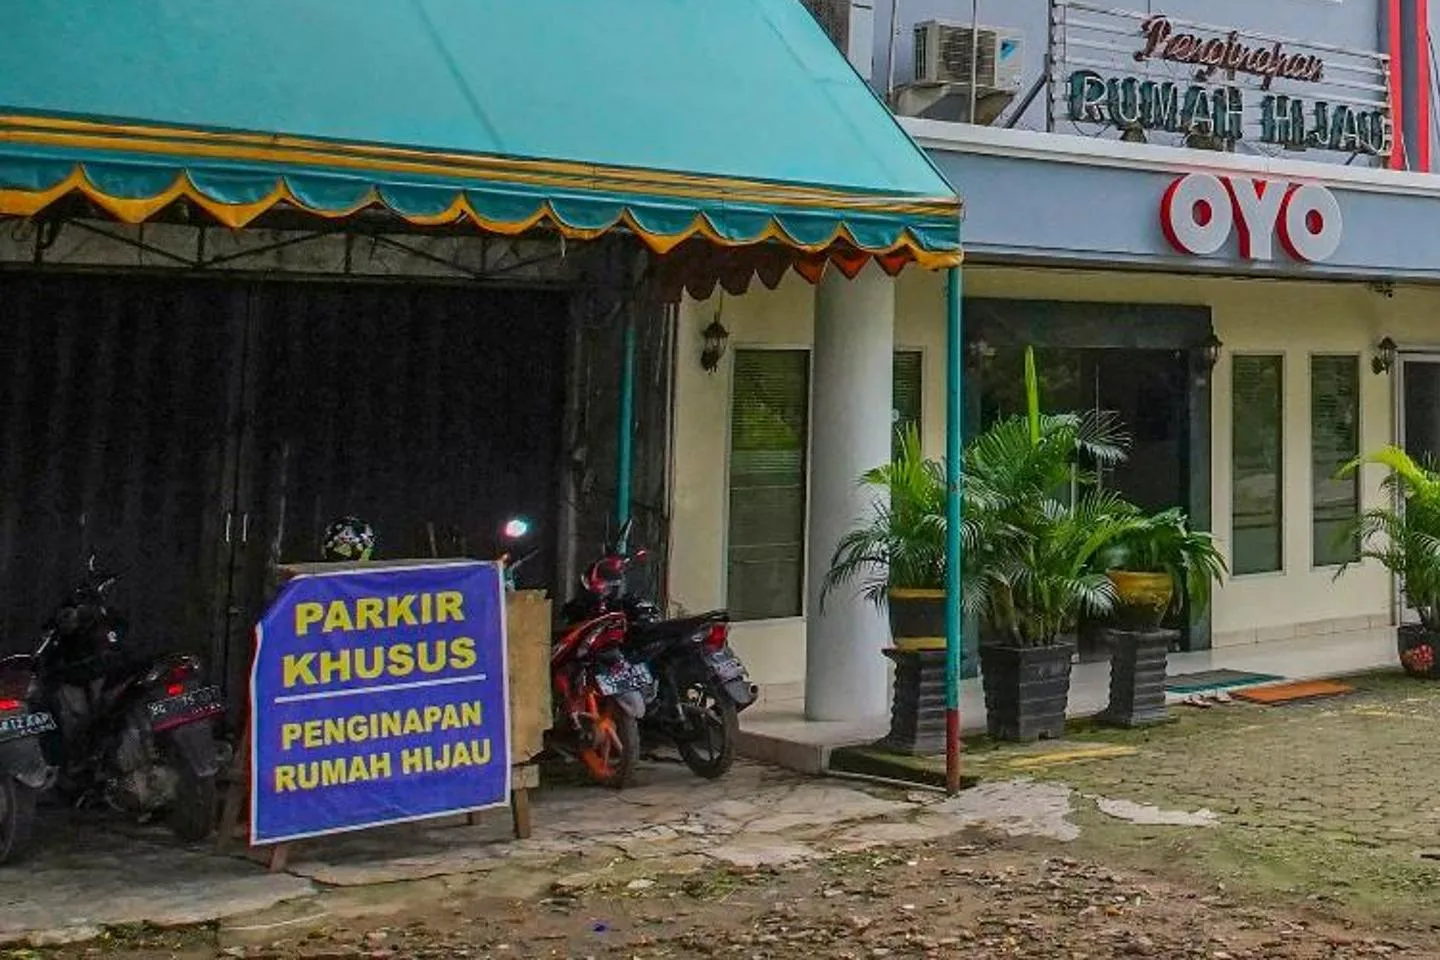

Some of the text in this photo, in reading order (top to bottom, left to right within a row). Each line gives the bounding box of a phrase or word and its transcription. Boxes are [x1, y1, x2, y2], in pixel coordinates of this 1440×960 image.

[1068, 69, 1393, 153] RUMAH HIJAU
[1160, 172, 1343, 263] OYO
[295, 591, 465, 637] PARKIR
[282, 637, 477, 688] KHUSUS
[282, 701, 482, 750] PENGINAPAN
[275, 739, 492, 793] RUMAH HIJAU
